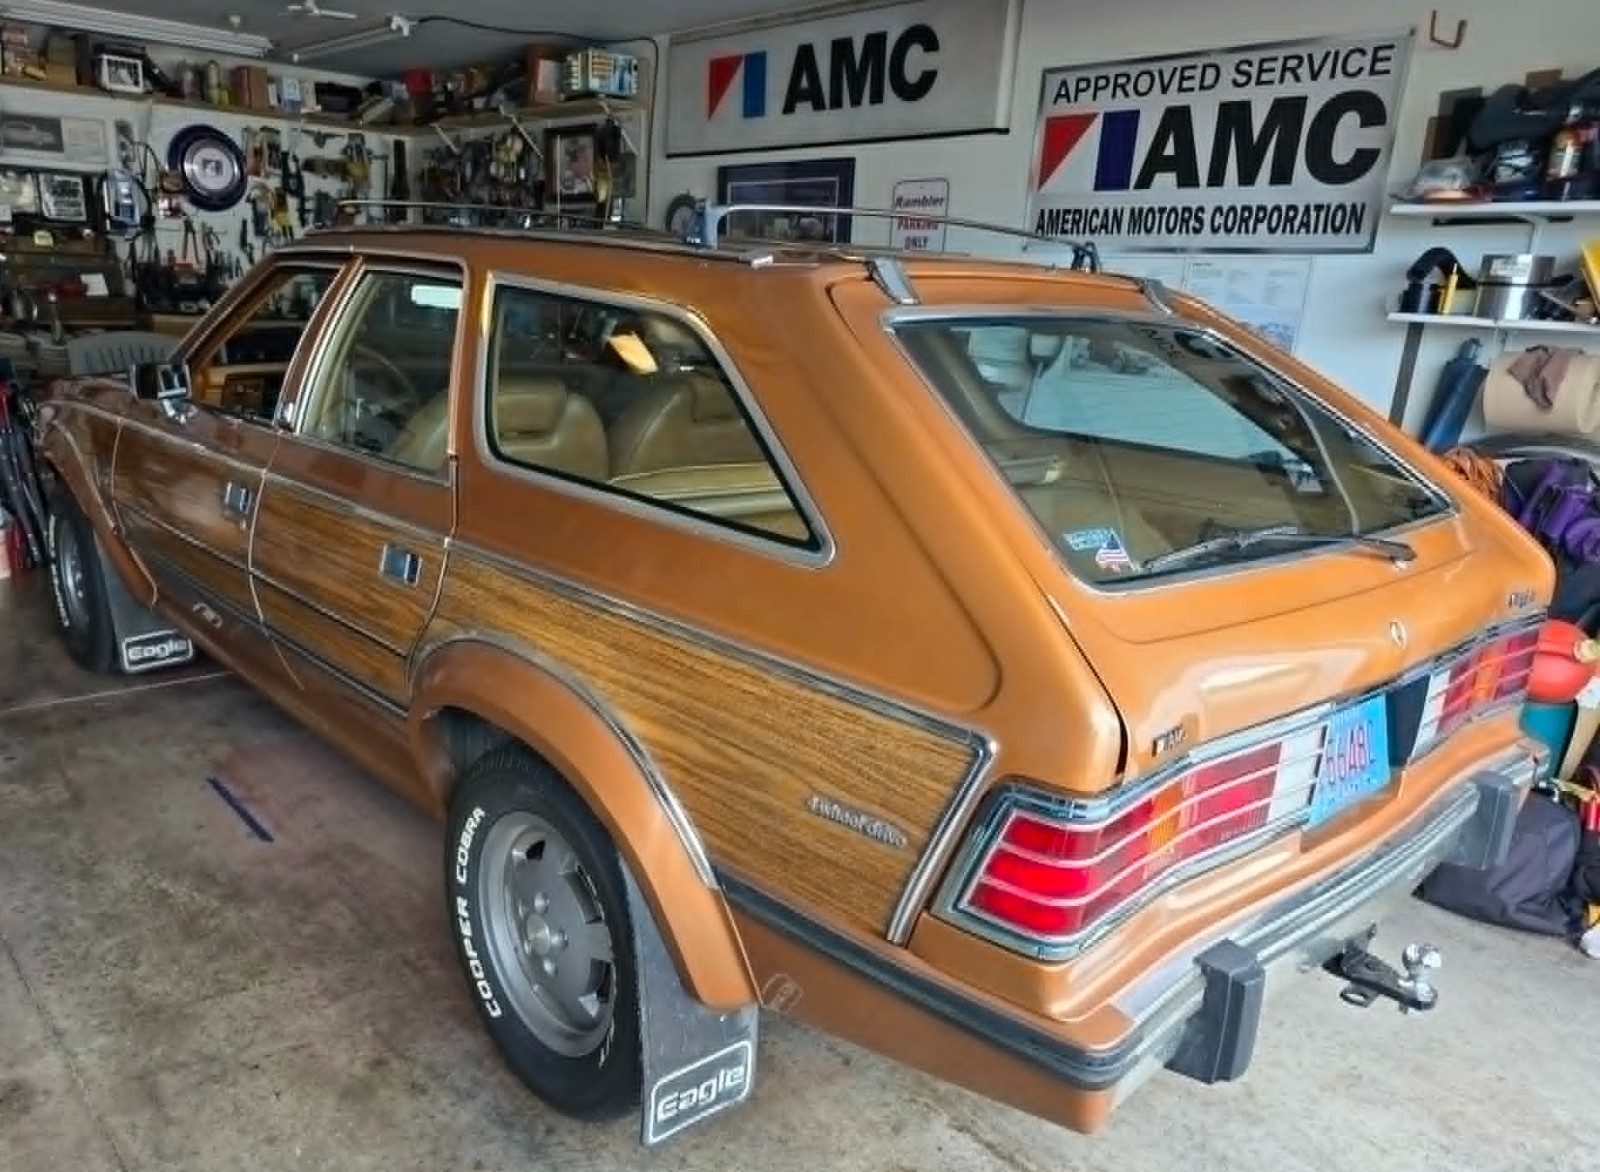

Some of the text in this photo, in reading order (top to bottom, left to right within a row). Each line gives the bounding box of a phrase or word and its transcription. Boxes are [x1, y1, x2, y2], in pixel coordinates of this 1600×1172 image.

[782, 24, 939, 114] AMC
[1053, 43, 1395, 105] APPROVED SERVICE
[1134, 89, 1387, 191] AMC
[1035, 203, 1365, 236] AMERICAN MOTORS CORPORATION
[456, 806, 502, 1018] COOPER COBRA
[657, 1065, 745, 1122] Eagle
